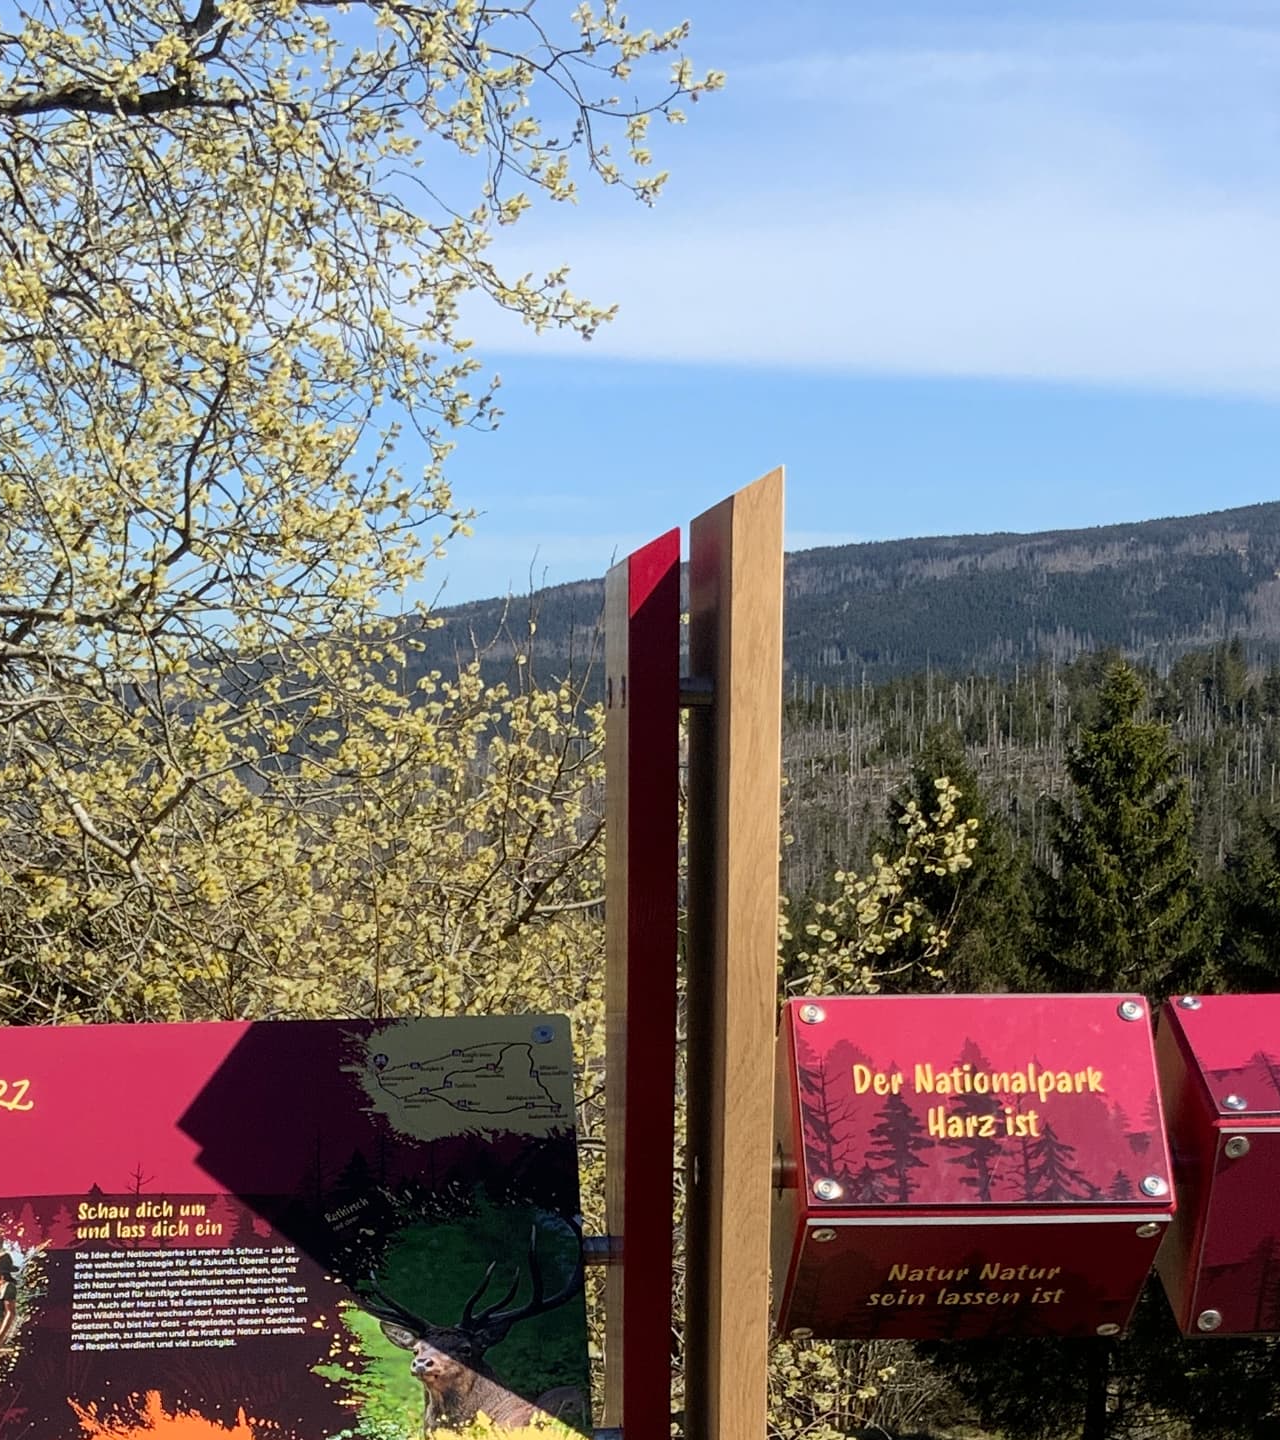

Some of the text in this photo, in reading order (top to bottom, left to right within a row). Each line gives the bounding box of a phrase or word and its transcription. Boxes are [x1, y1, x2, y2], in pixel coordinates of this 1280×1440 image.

[853, 1062, 1105, 1102] Der Nationalpark
[927, 1109, 1040, 1139] Harz ist
[77, 1201, 206, 1220] Schau dich um
[76, 1219, 223, 1240] und lass dich ein
[887, 1262, 1062, 1282] Natur Natur
[867, 1286, 1065, 1307] sein lassen ist
